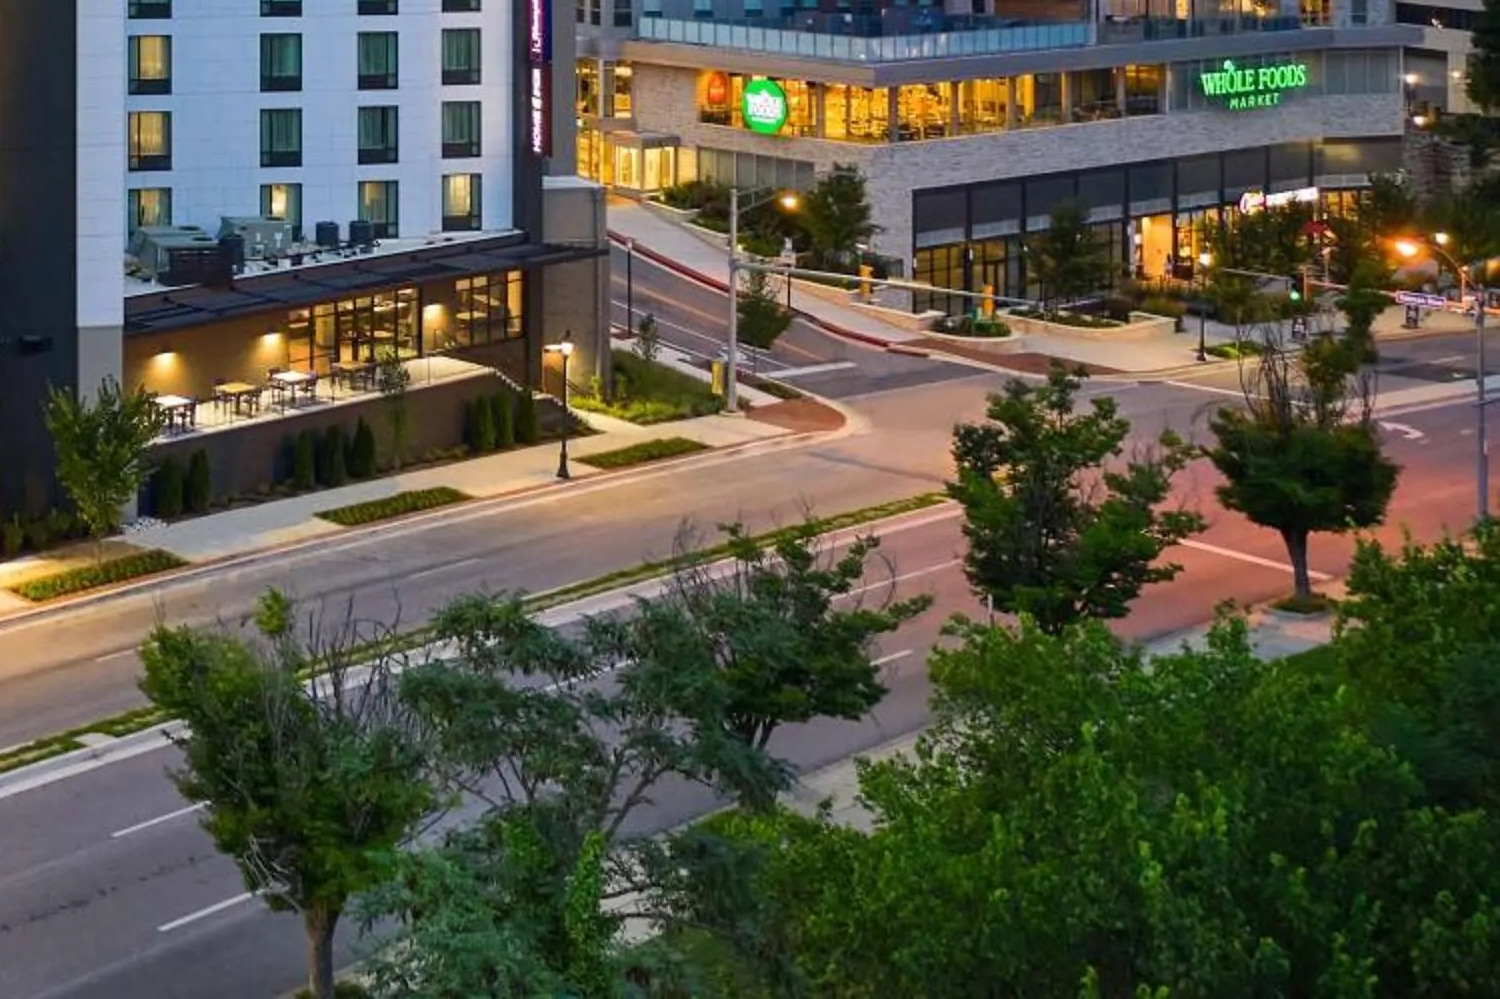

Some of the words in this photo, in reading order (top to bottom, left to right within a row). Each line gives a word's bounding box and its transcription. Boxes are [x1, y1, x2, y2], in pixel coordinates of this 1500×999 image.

[1201, 68, 1255, 96] WHOLE
[1258, 64, 1306, 89] FOODS
[1229, 92, 1280, 110] MARKET
